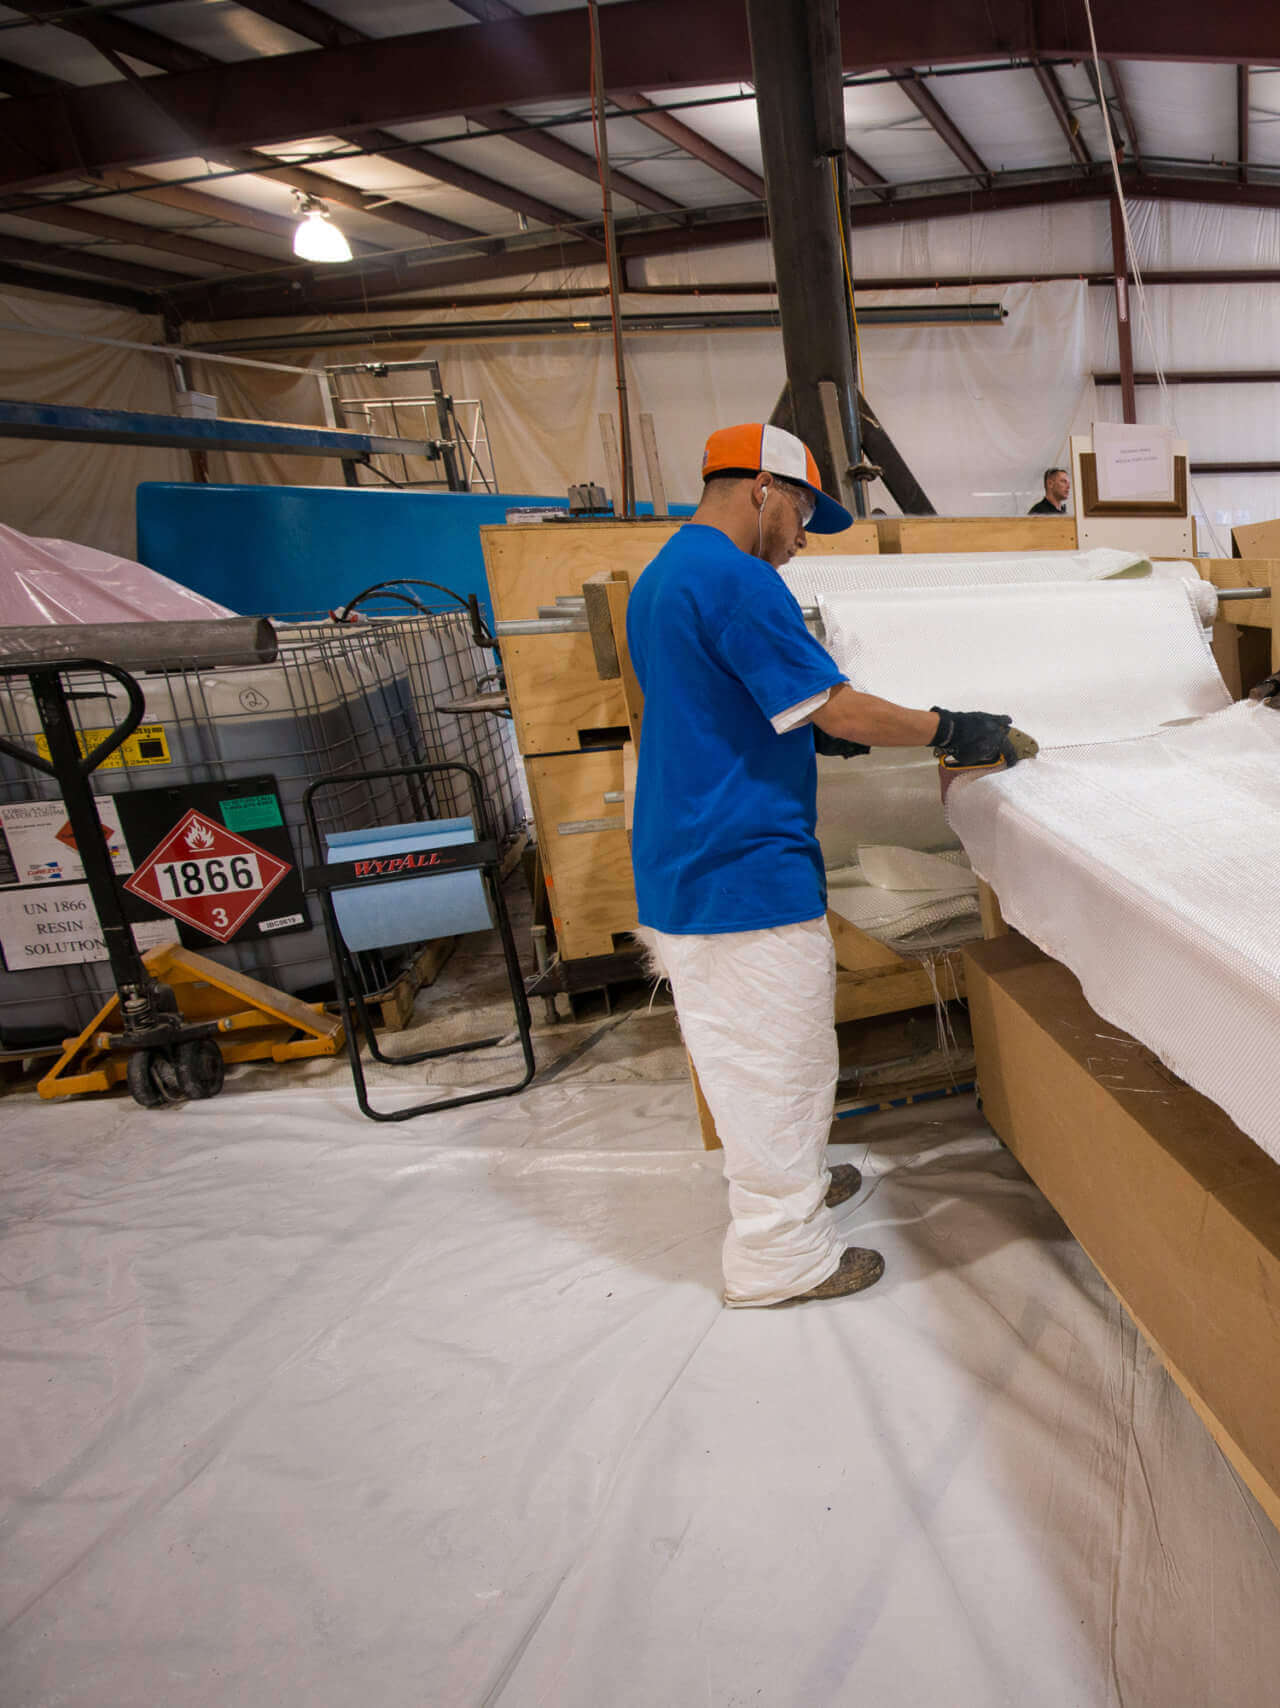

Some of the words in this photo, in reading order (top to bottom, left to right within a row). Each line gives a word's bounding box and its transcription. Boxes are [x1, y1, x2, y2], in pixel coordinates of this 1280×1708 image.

[162, 856, 254, 898] 1866
[23, 902, 48, 916] UN
[53, 899, 87, 913] 1866
[211, 907, 229, 928] 3
[36, 919, 84, 935] RESIN
[24, 938, 107, 956] SOLUTION
